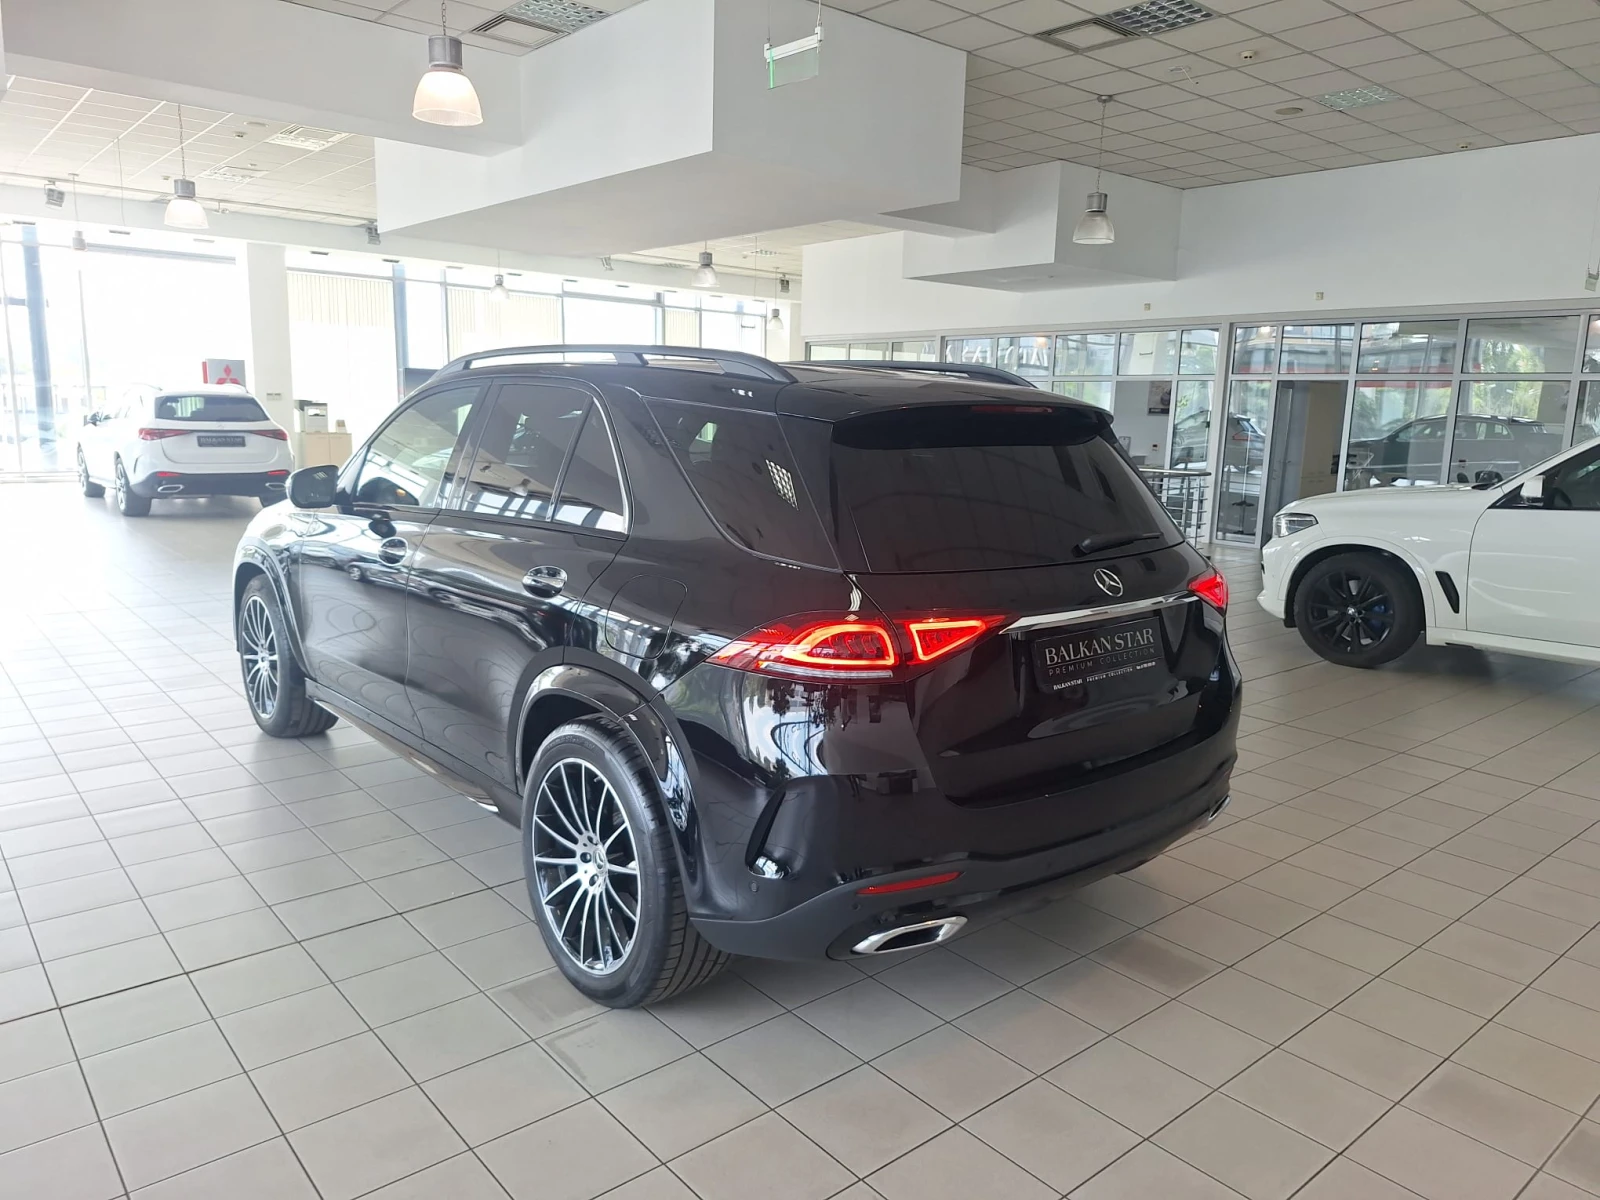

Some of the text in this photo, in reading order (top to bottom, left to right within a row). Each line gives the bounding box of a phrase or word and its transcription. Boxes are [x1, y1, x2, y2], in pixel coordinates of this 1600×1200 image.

[1045, 628, 1154, 665] BALKAN STAR
[1048, 648, 1155, 677] PREMIUM COLLECTION
